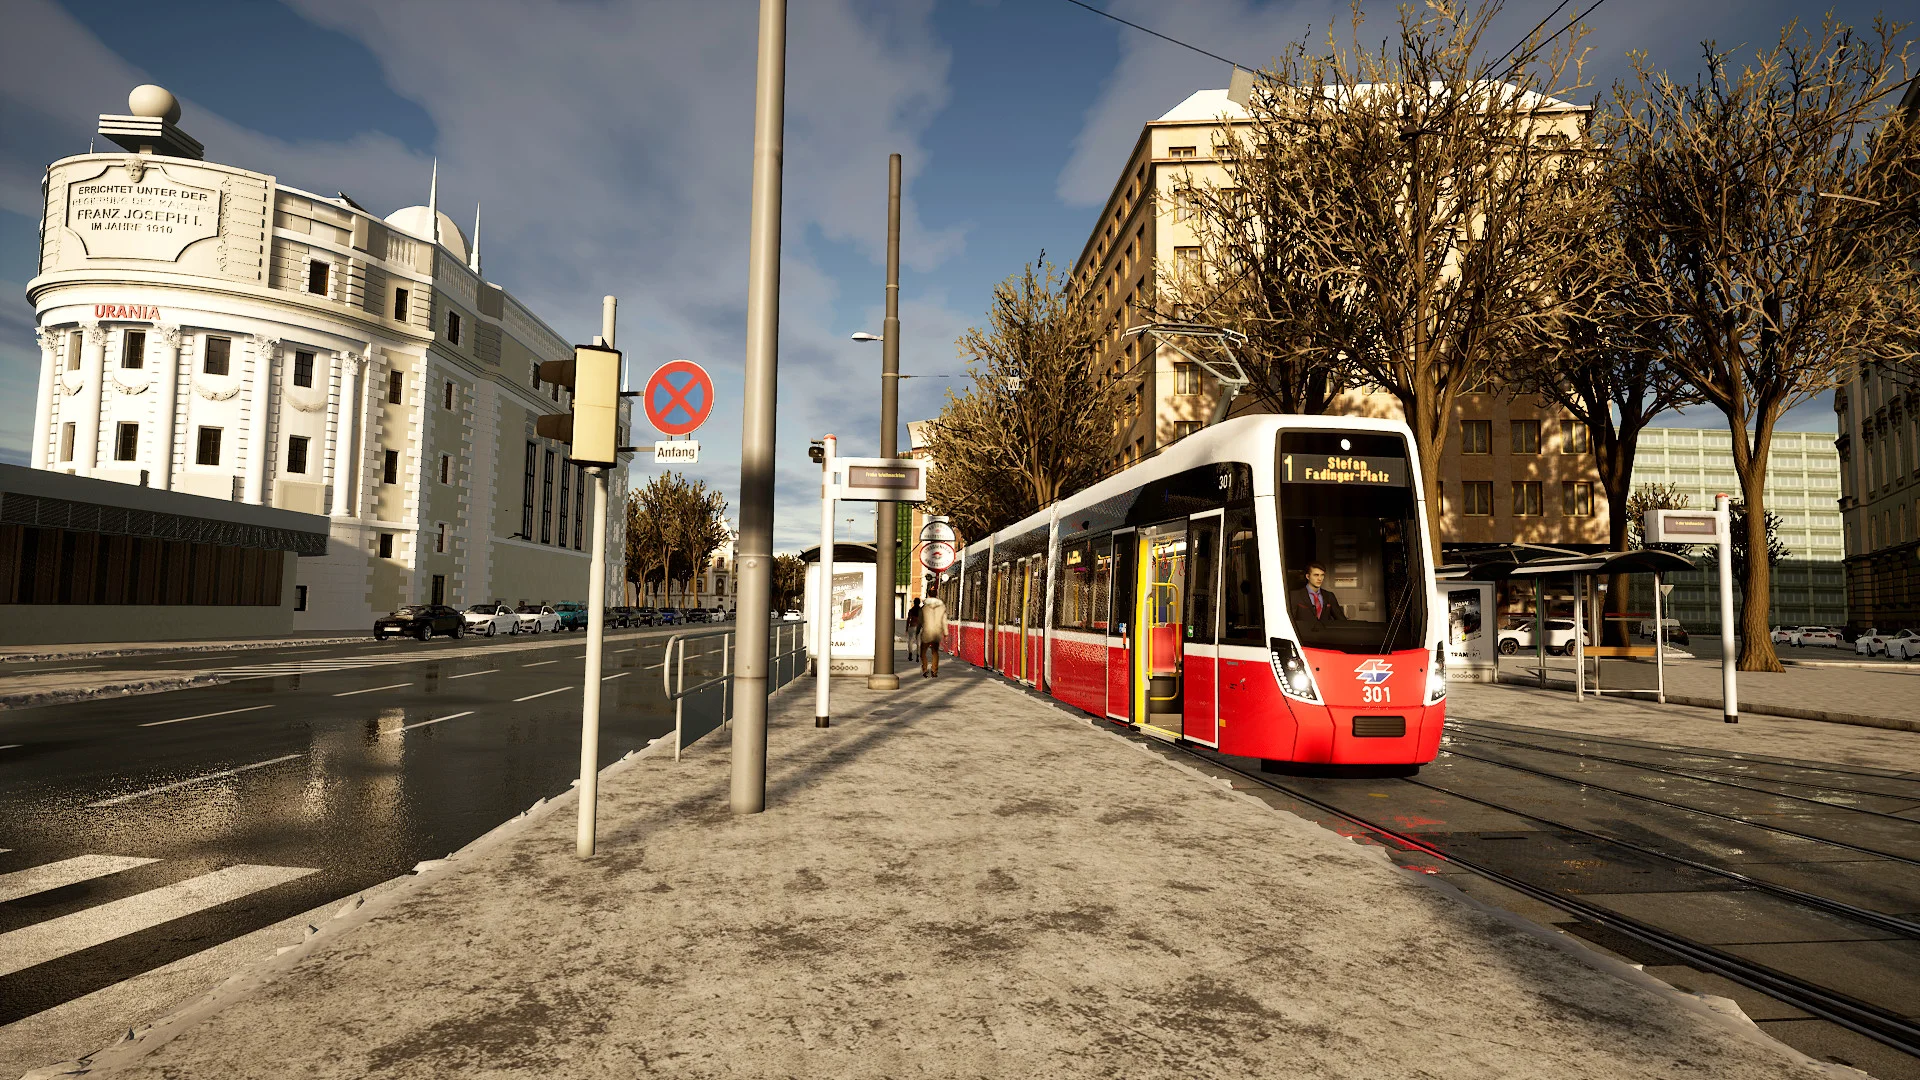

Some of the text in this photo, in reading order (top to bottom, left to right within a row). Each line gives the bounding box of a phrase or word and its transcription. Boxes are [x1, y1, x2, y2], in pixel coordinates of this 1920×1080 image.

[78, 185, 208, 202] ERRICHTET UNTER DER
[77, 208, 121, 220] FRANZ
[123, 209, 188, 225] JOSEPH
[91, 222, 173, 234] IM JAHRE 1910
[95, 304, 161, 320] URANIA
[657, 446, 695, 460] Anfang
[1284, 454, 1293, 482] 1
[1327, 456, 1367, 471] Stefan
[1218, 473, 1232, 490] 301
[1305, 467, 1390, 483] Fadinger-Platz
[1362, 685, 1391, 703] 301
